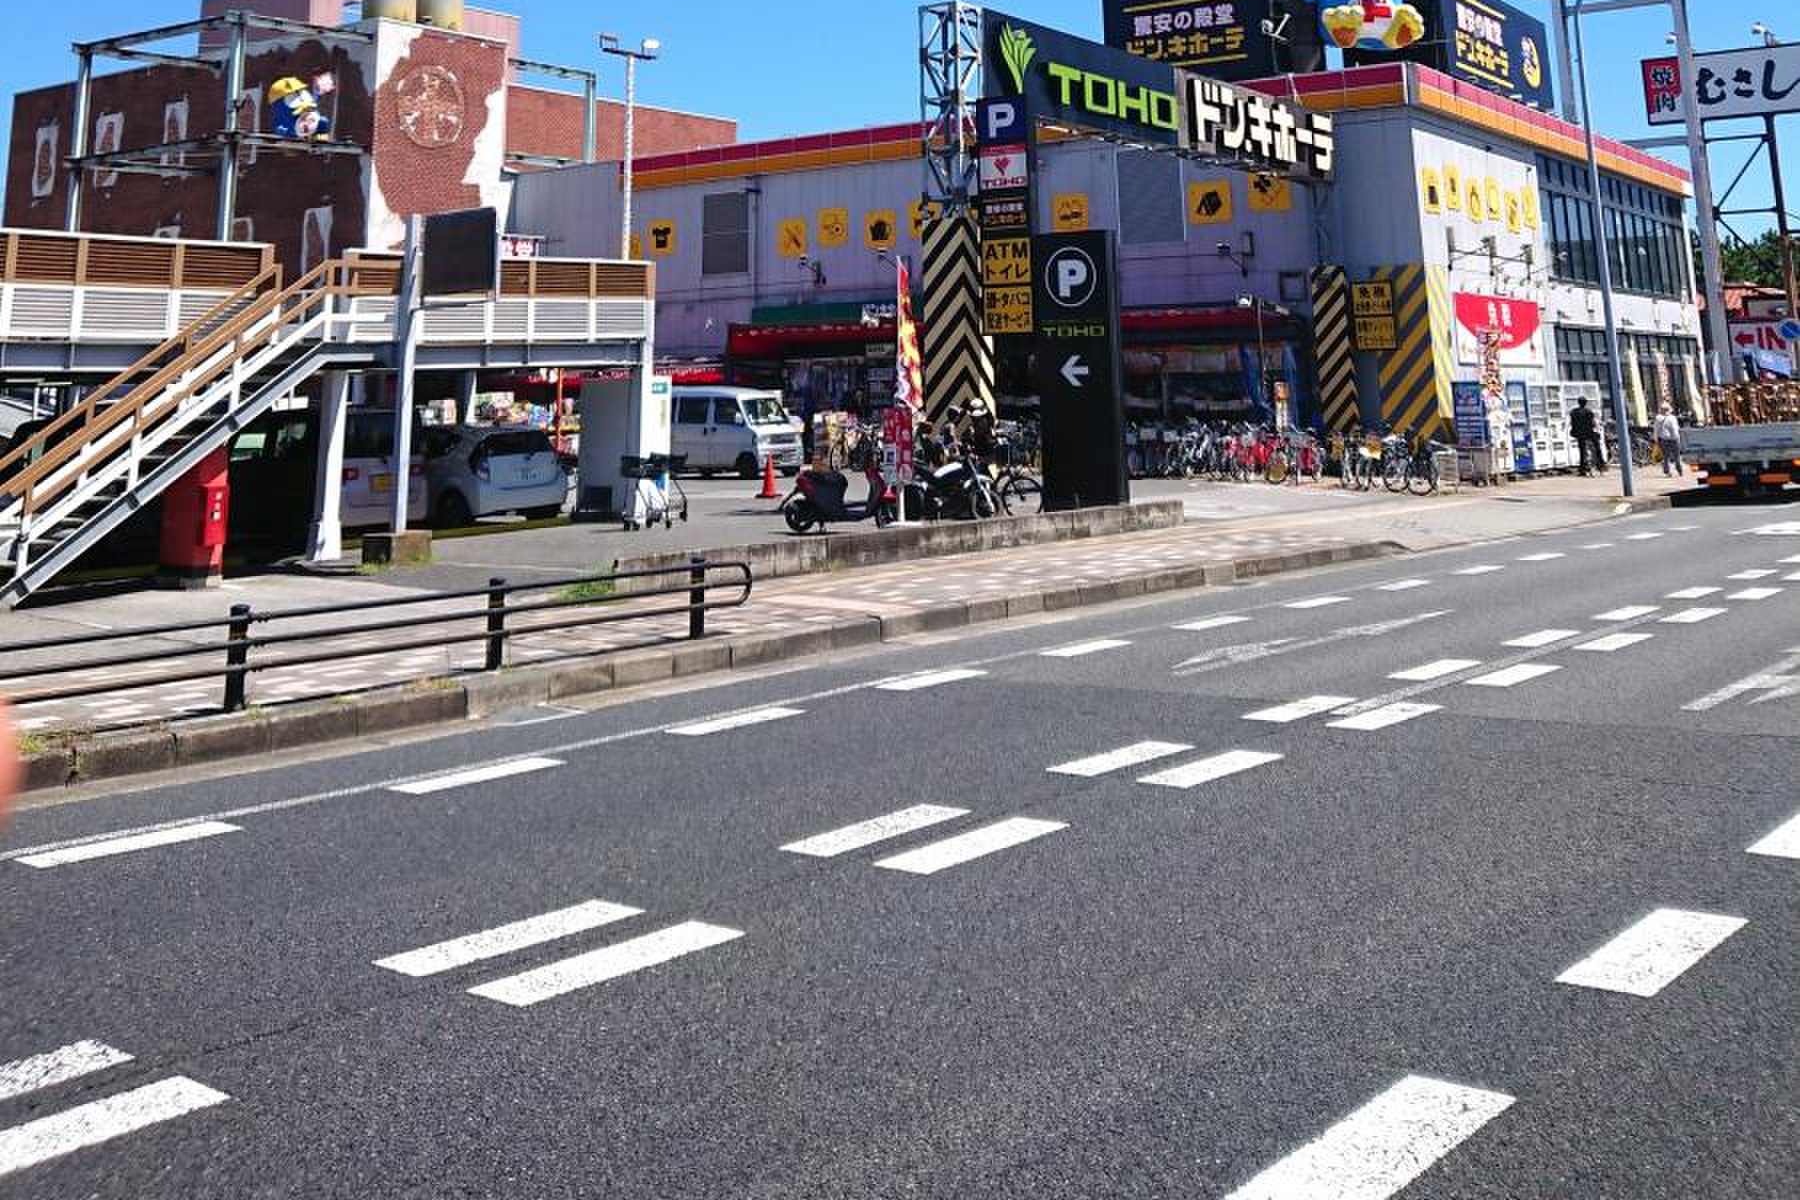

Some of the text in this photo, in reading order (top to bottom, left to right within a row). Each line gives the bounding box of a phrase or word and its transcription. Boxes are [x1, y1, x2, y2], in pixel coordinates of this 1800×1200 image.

[1047, 61, 1180, 132] TOHO
[1696, 59, 1800, 106] むさし
[987, 102, 1016, 138] P
[985, 241, 1028, 260] ATM
[985, 263, 1029, 281] トイレ
[1057, 259, 1088, 298] P
[1757, 327, 1787, 350] IN
